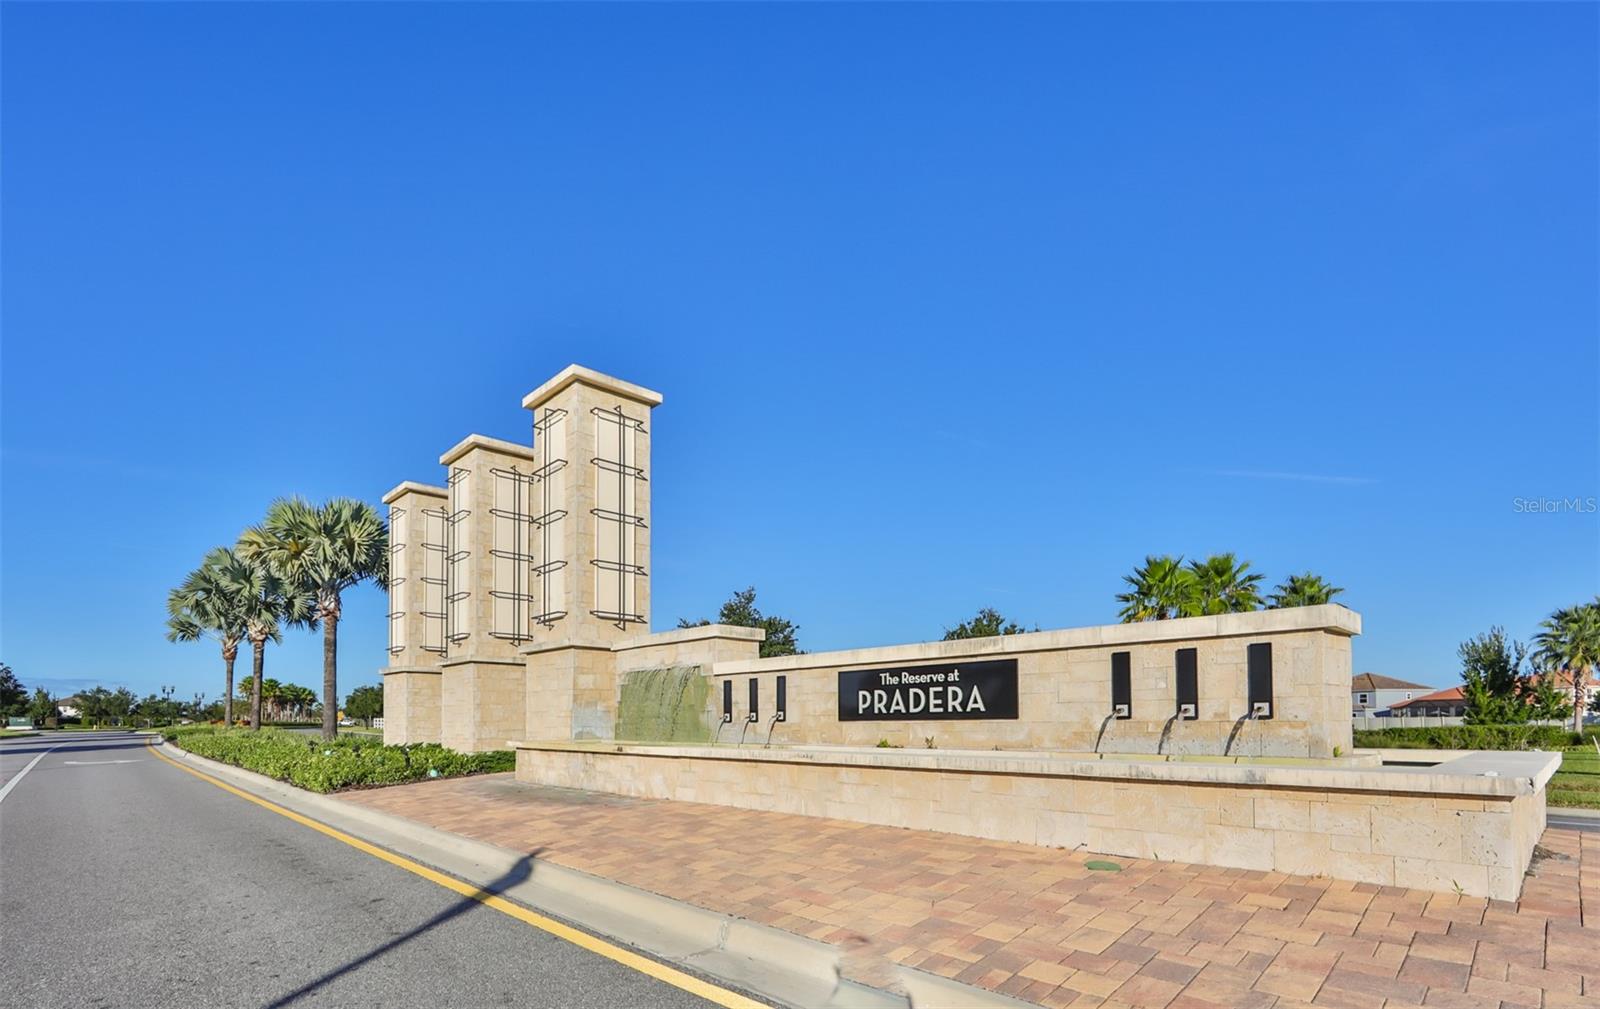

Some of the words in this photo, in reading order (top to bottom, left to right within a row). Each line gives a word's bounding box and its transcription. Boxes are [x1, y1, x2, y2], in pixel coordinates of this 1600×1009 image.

[879, 672, 899, 686] The
[901, 671, 945, 685] Reserve
[947, 669, 960, 682] at
[858, 684, 986, 715] PRADERA
